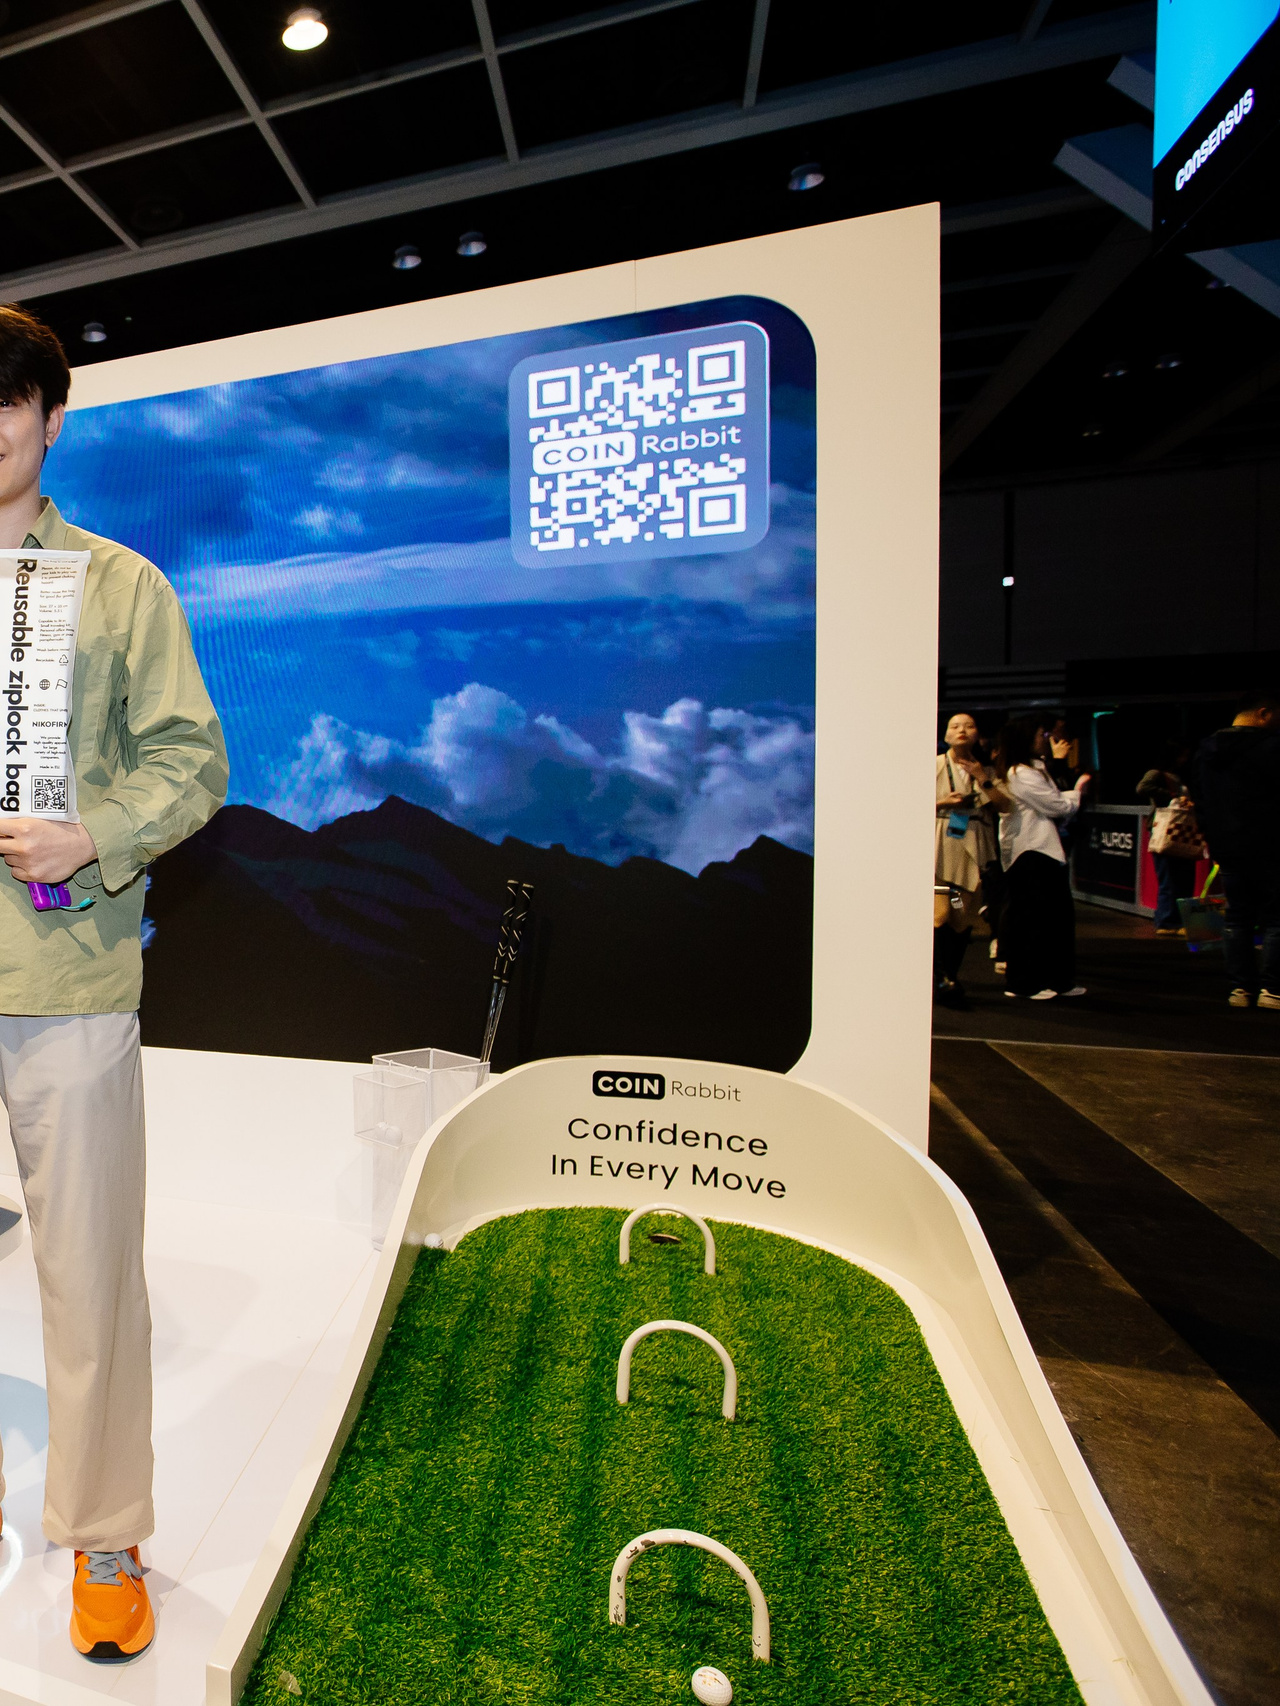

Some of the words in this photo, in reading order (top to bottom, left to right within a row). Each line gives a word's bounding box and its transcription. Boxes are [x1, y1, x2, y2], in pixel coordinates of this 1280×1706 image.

[543, 440, 624, 465] COIN
[642, 425, 741, 455] Rabbit
[10, 558, 38, 662] Reusable
[2, 670, 30, 755] ziplock
[0, 764, 27, 812] bag
[597, 1076, 660, 1096] COIN
[671, 1080, 742, 1102] Rabbit
[568, 1117, 768, 1156] Confidence
[552, 1154, 578, 1176] In
[590, 1155, 679, 1190] Every
[692, 1164, 786, 1199] Move
